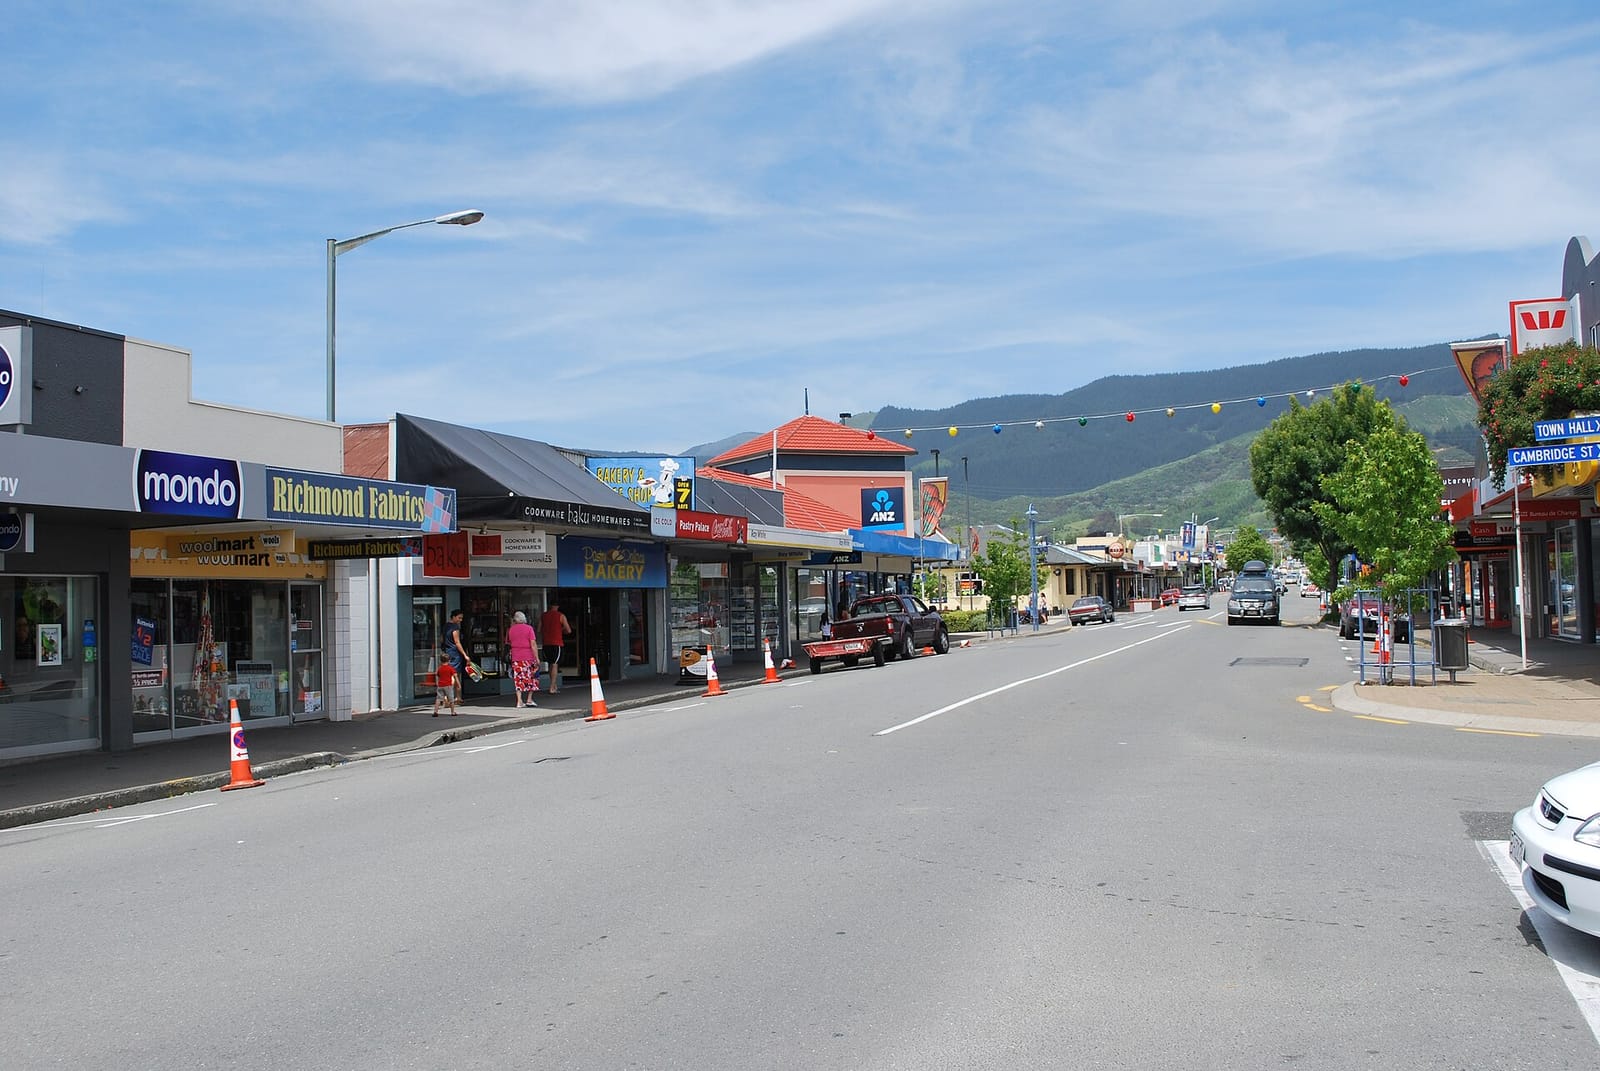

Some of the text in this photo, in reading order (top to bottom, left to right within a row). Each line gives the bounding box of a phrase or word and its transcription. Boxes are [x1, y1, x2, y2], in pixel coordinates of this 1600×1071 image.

[1536, 420, 1595, 437] TOWN HALL
[1513, 445, 1594, 463] CAMBRIDGE ST
[597, 467, 635, 484] BAKERY
[144, 469, 237, 507] mondo
[676, 488, 691, 503] 7
[273, 476, 425, 523] Richmond Fabrics
[524, 506, 565, 520] COOKWARE
[567, 503, 590, 525] baku
[591, 514, 631, 526] HOMEWARES
[870, 511, 896, 522] ANZ
[679, 520, 710, 533] Pastry Palace
[180, 537, 255, 553] woolmart
[313, 541, 400, 557] Richmond Fabrics
[426, 535, 467, 570] baku
[833, 555, 850, 563] ANZ
[584, 563, 645, 581] BAKERY
